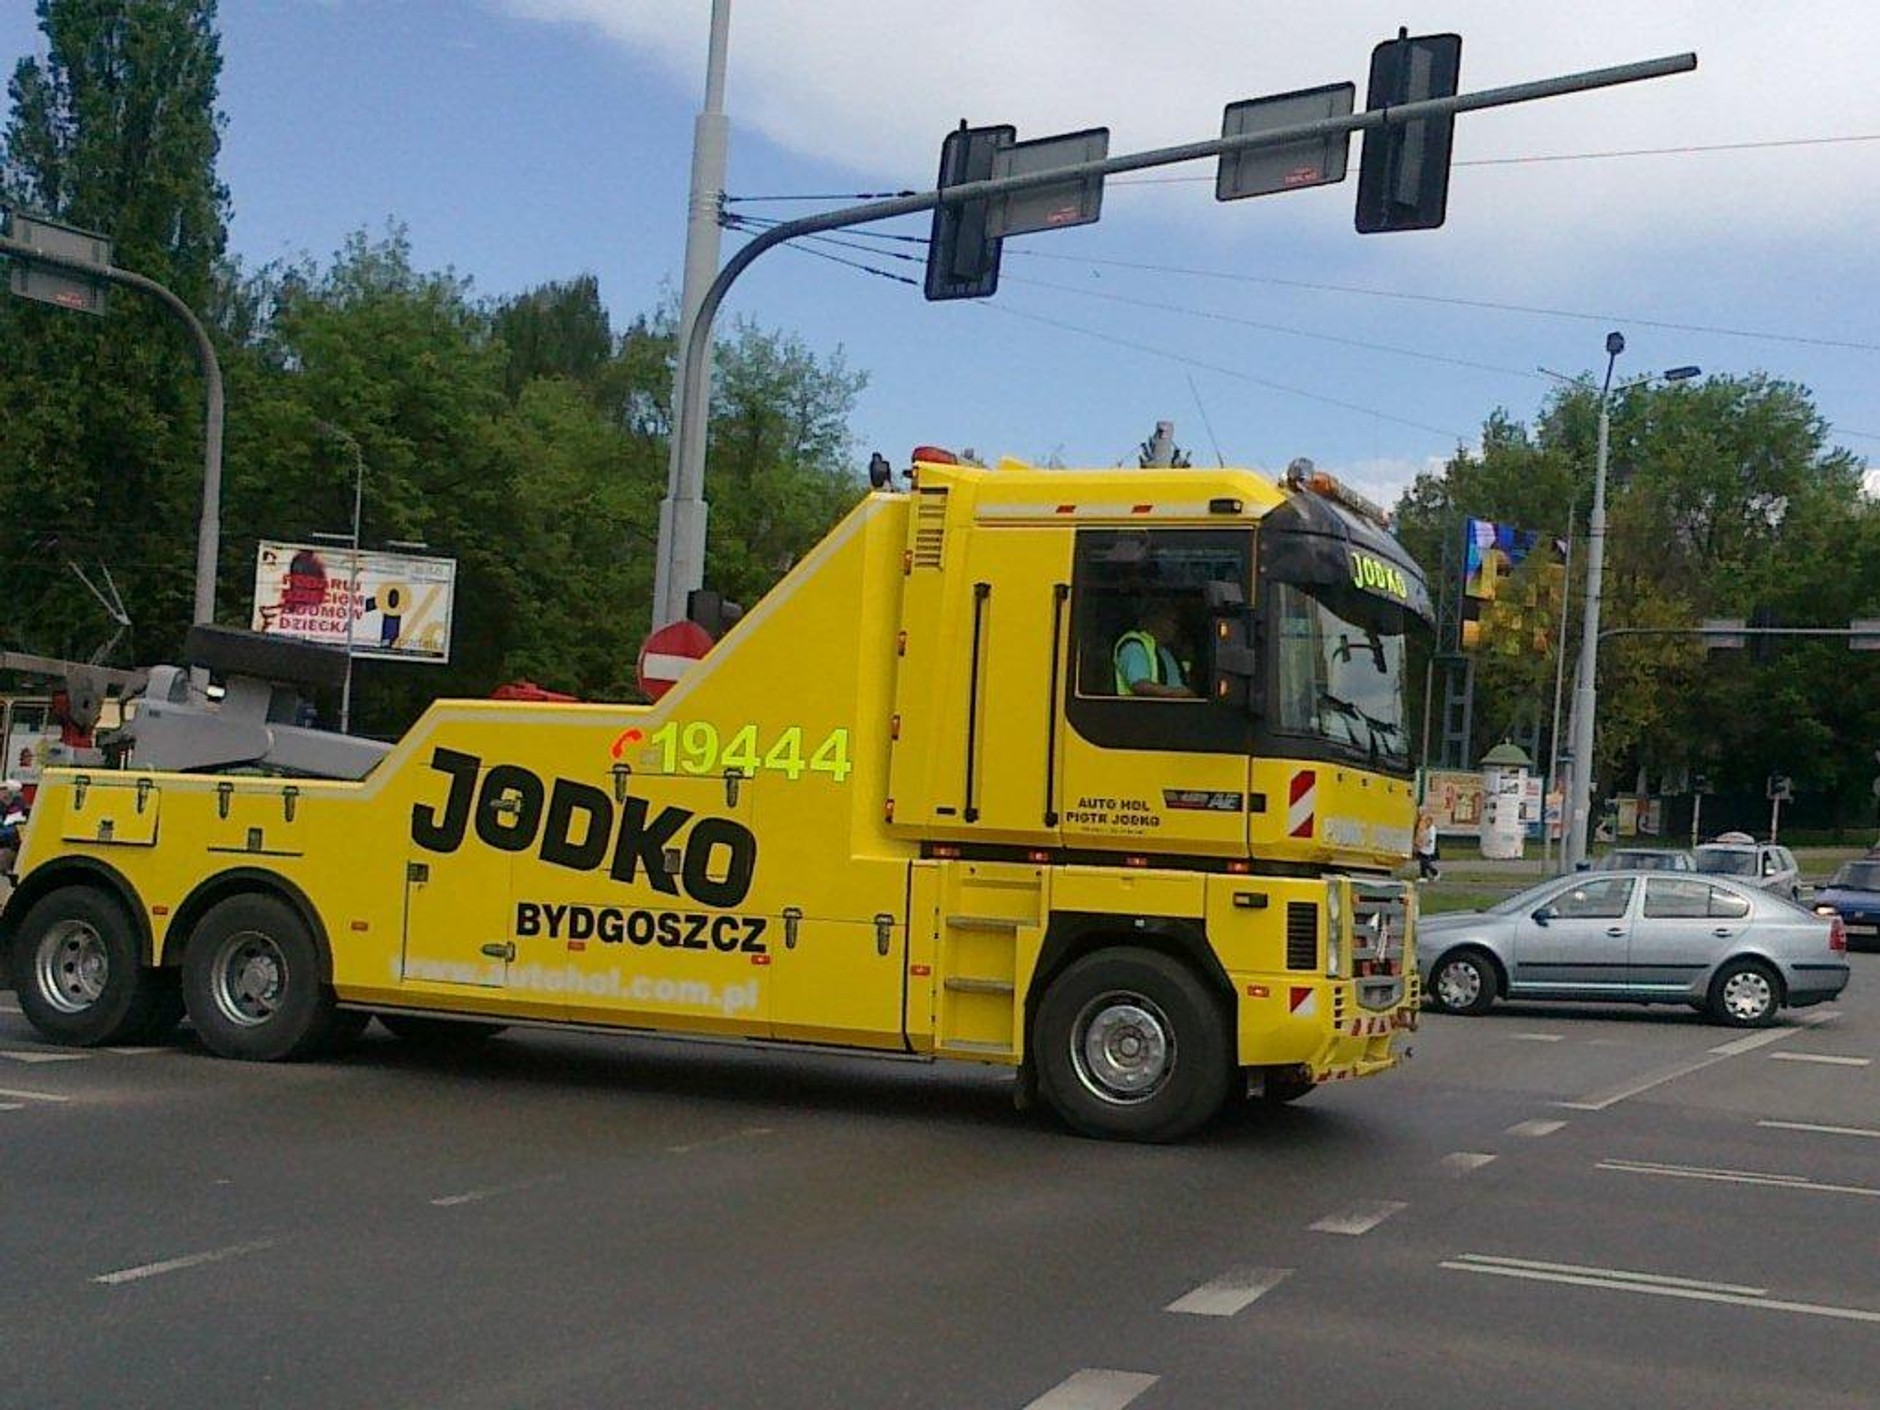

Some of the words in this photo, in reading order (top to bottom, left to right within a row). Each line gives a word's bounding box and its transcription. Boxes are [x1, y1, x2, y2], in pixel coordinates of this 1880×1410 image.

[1351, 552, 1407, 598] JODKO
[651, 721, 852, 782] 19444
[411, 747, 758, 908] JODKO
[1066, 811, 1107, 824] PIOTR
[1112, 814, 1160, 827] JODKO
[1078, 797, 1116, 809] AUTO
[1121, 800, 1150, 812] HOL
[516, 902, 768, 954] BYDGOSZCZ
